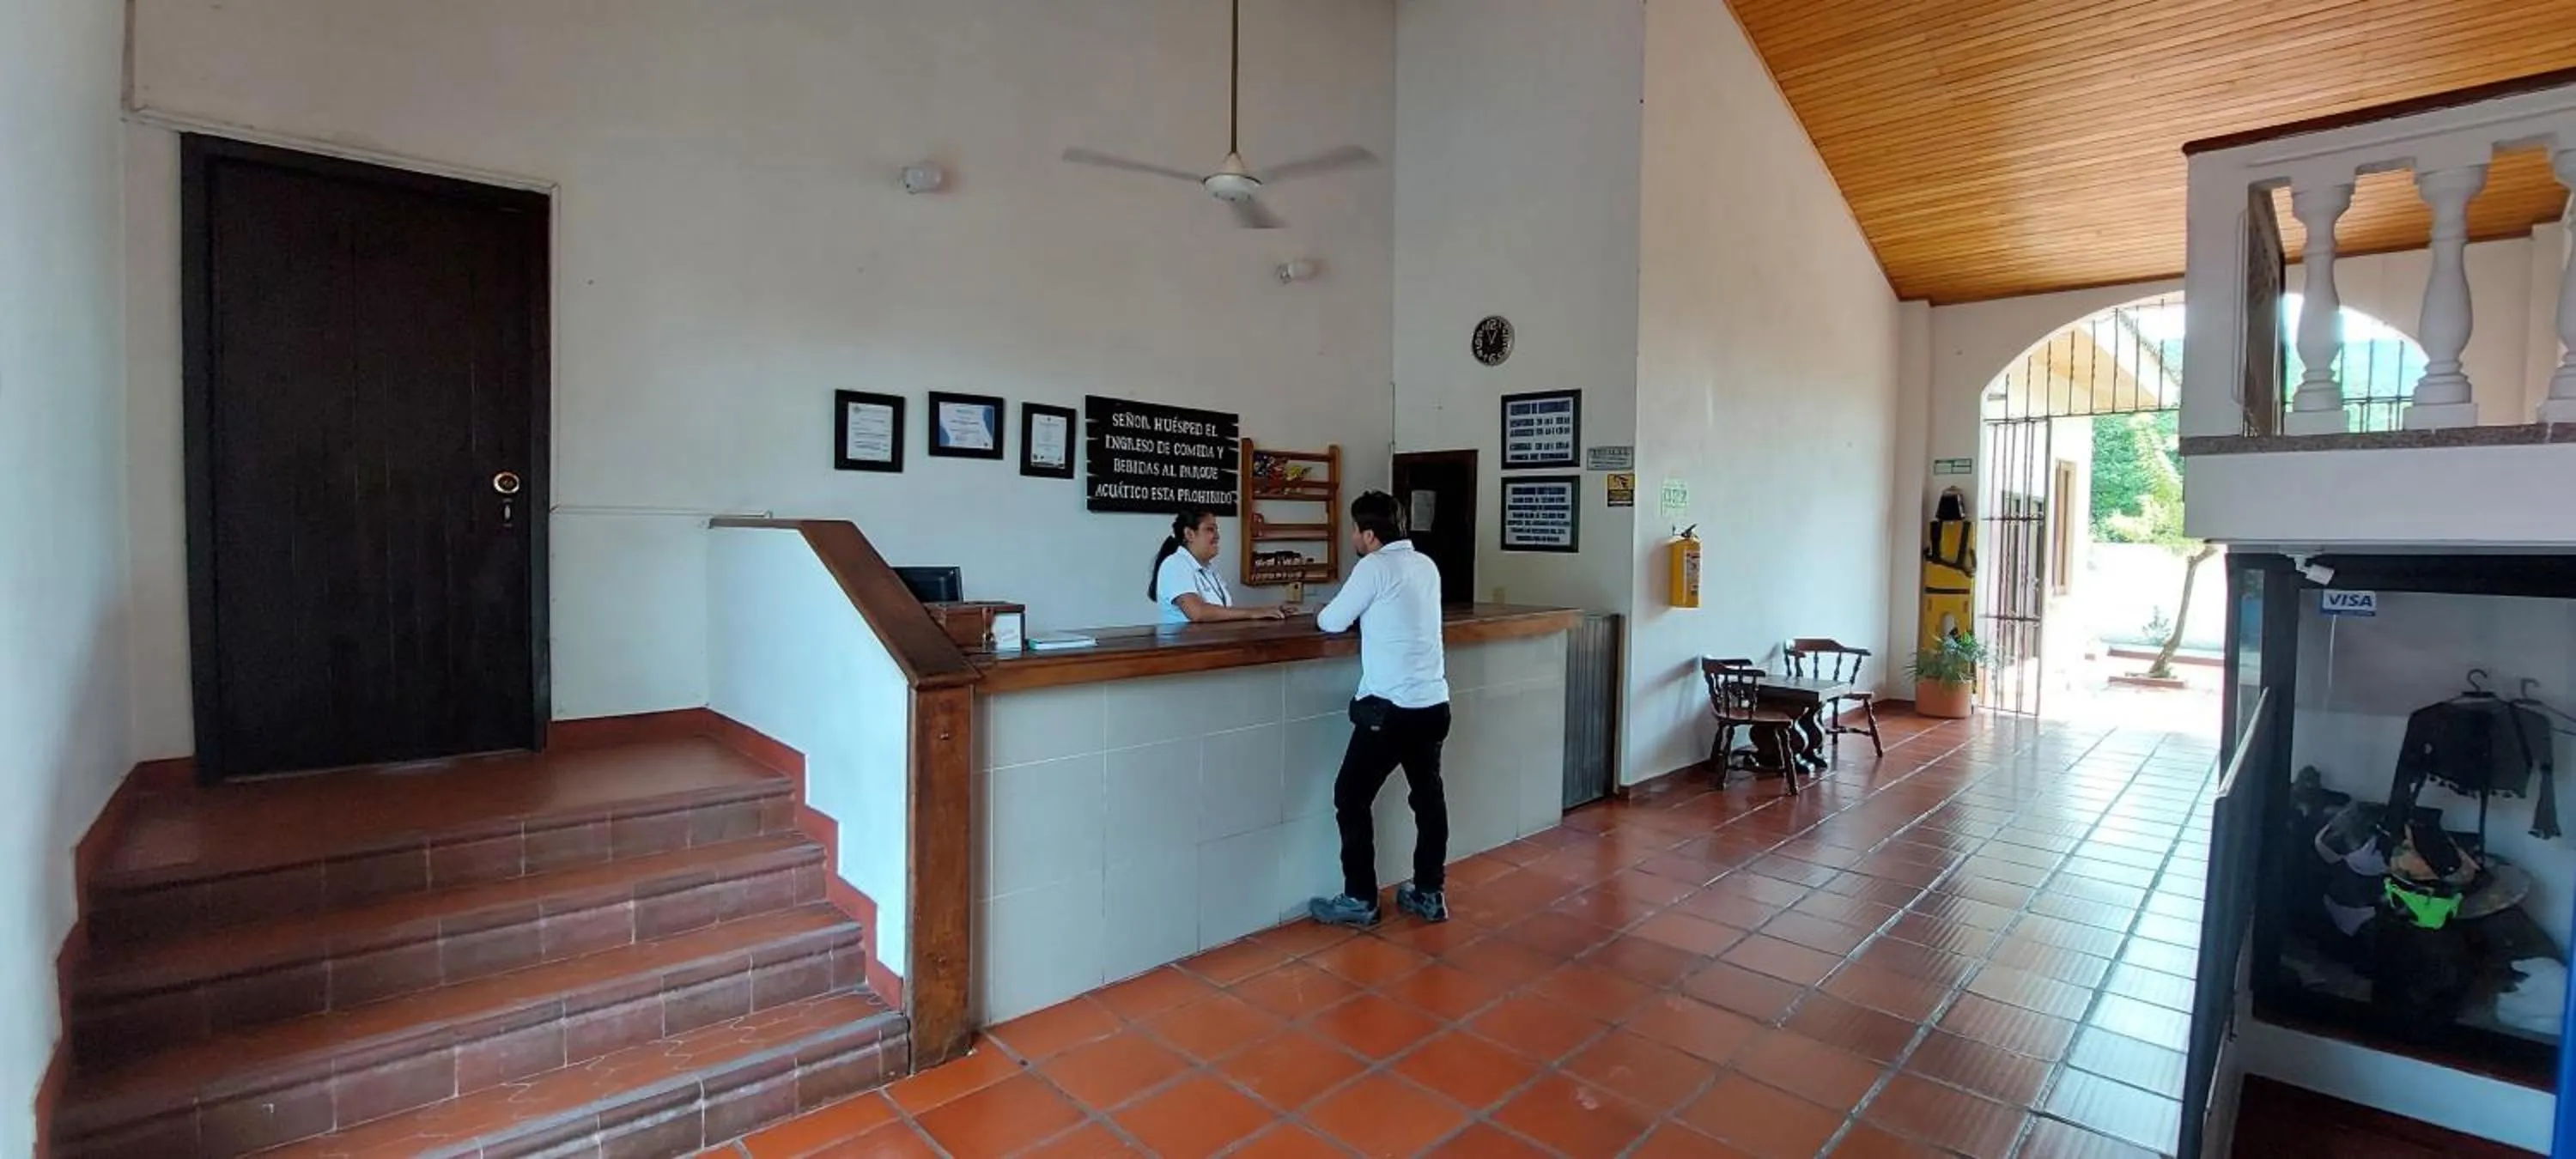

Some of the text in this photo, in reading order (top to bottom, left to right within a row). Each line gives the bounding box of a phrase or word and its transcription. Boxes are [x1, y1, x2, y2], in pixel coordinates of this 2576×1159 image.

[1112, 411, 1218, 437] SEÑOR HUÉSPED EL
[1105, 434, 1224, 459] INGRESO DE COMIDA Y
[1114, 458, 1218, 480] BEBIDAS AL PARQUE
[1095, 481, 1232, 505] ACUÁTICO ESTA PROHIBIDO
[2330, 594, 2372, 607] VISA
